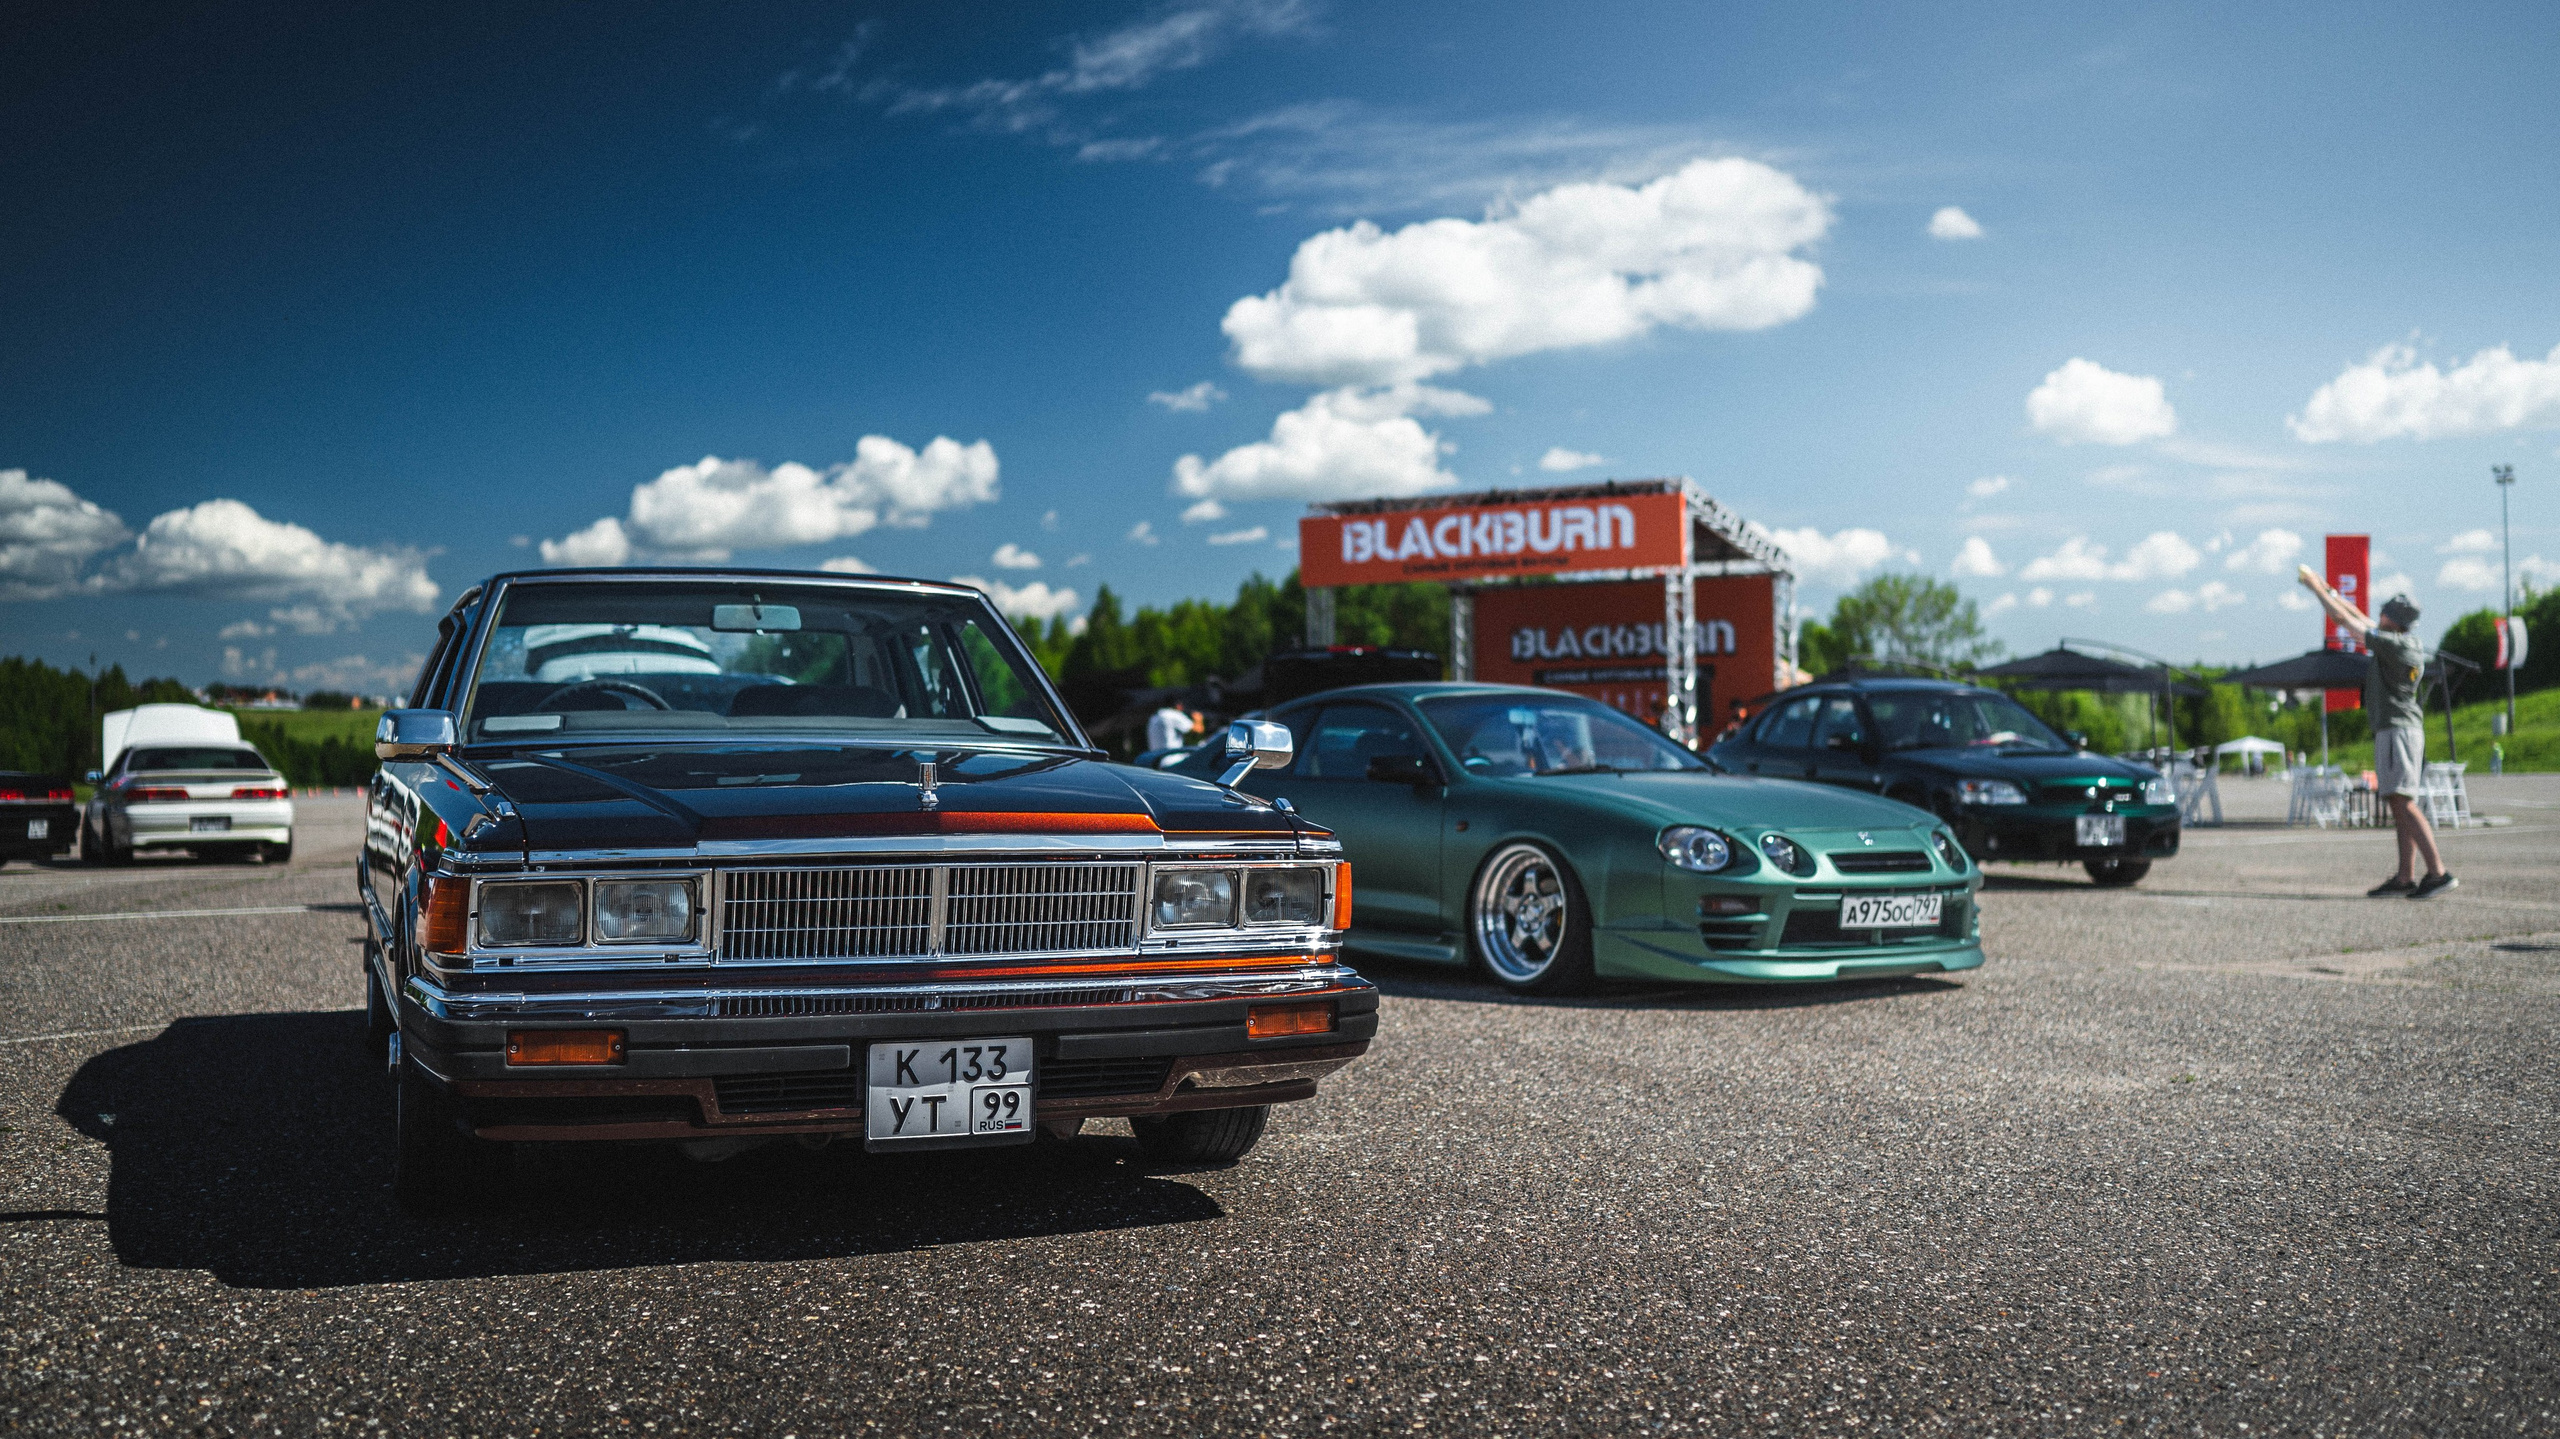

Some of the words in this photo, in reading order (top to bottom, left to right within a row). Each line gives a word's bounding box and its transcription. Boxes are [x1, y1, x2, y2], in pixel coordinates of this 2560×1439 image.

[1342, 504, 1635, 563] BLACKBURN
[1511, 620, 1736, 661] BLACKBN
[939, 1046, 1007, 1084] 133
[984, 1092, 1020, 1119] 99
[979, 1121, 1004, 1131] RUS
